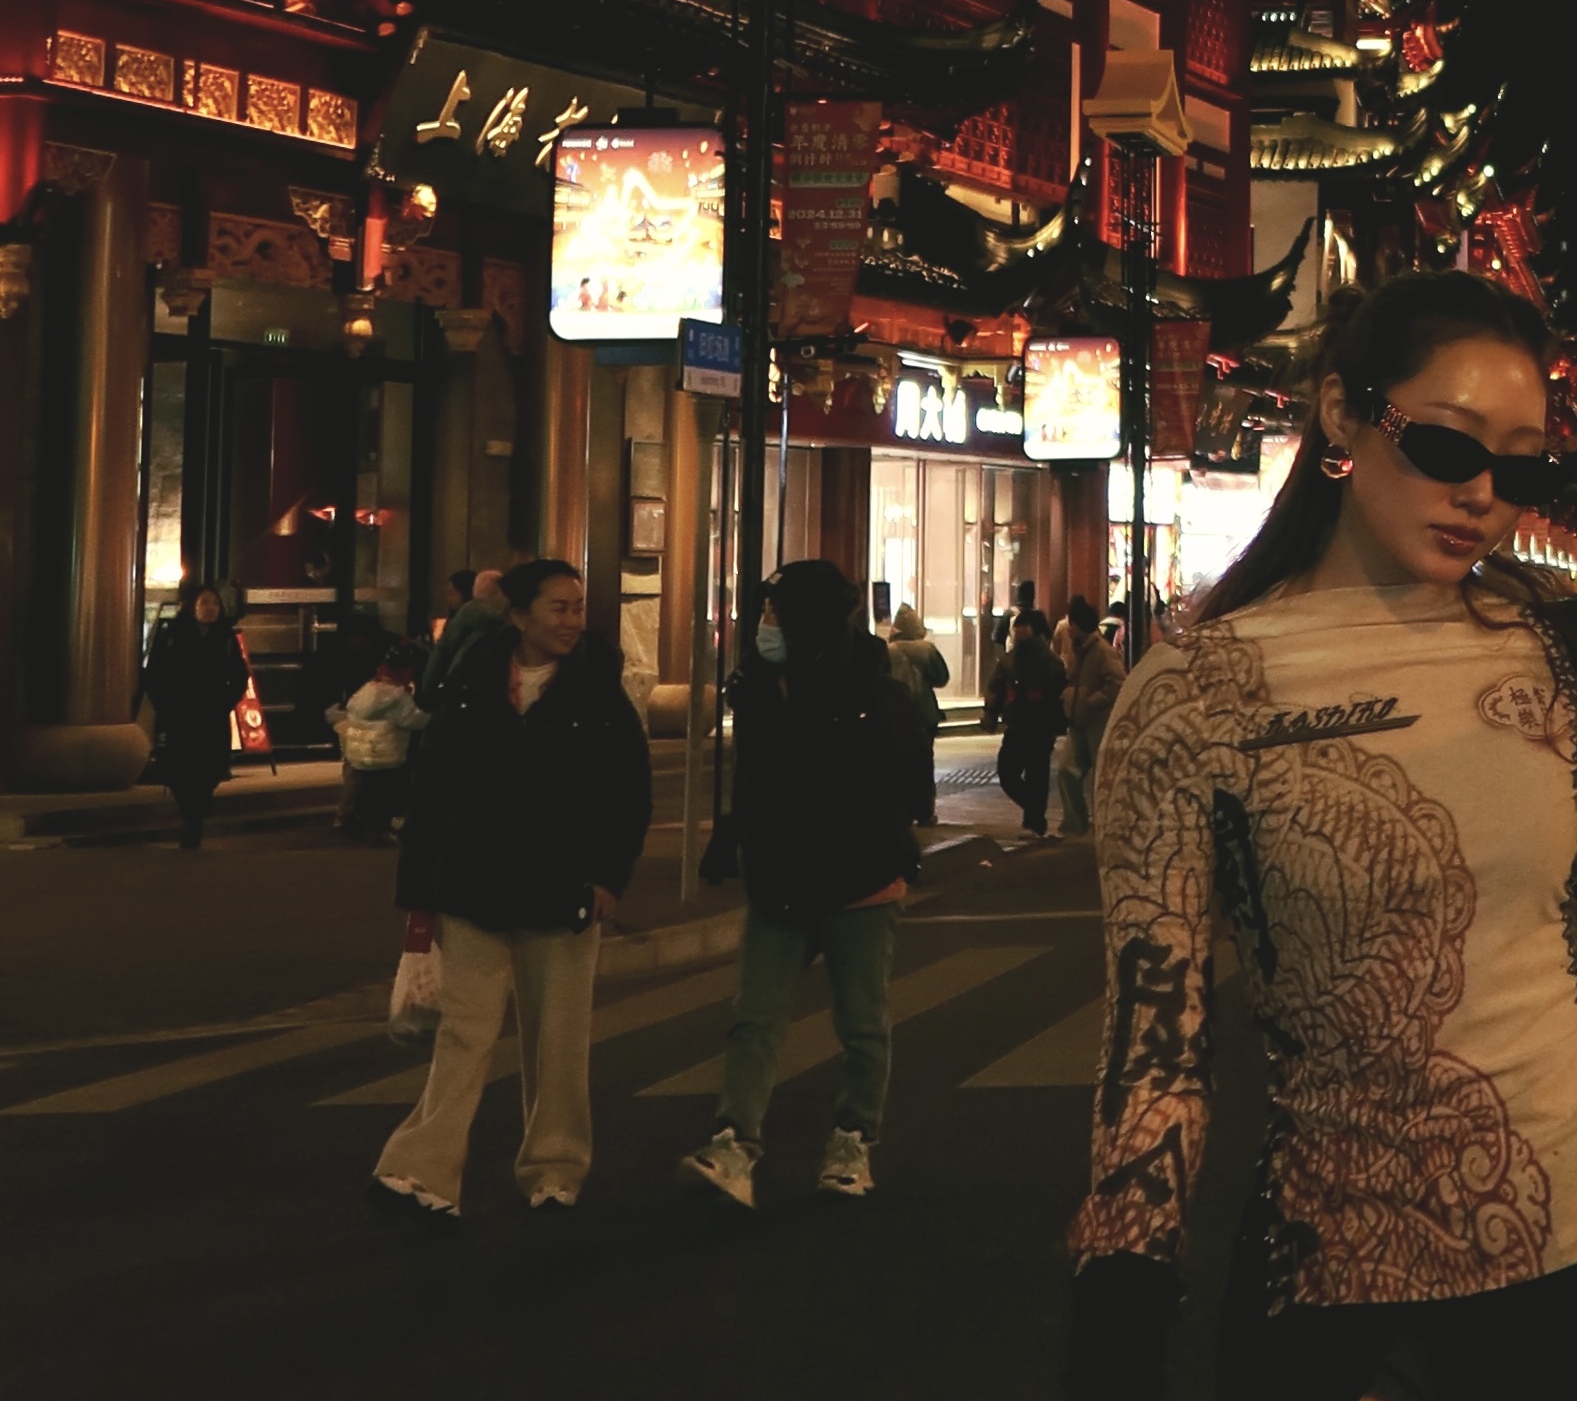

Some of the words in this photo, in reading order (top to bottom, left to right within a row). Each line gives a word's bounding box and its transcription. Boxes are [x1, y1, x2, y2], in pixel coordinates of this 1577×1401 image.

[414, 69, 592, 174] 上海老
[788, 209, 863, 220] 2024.12.31
